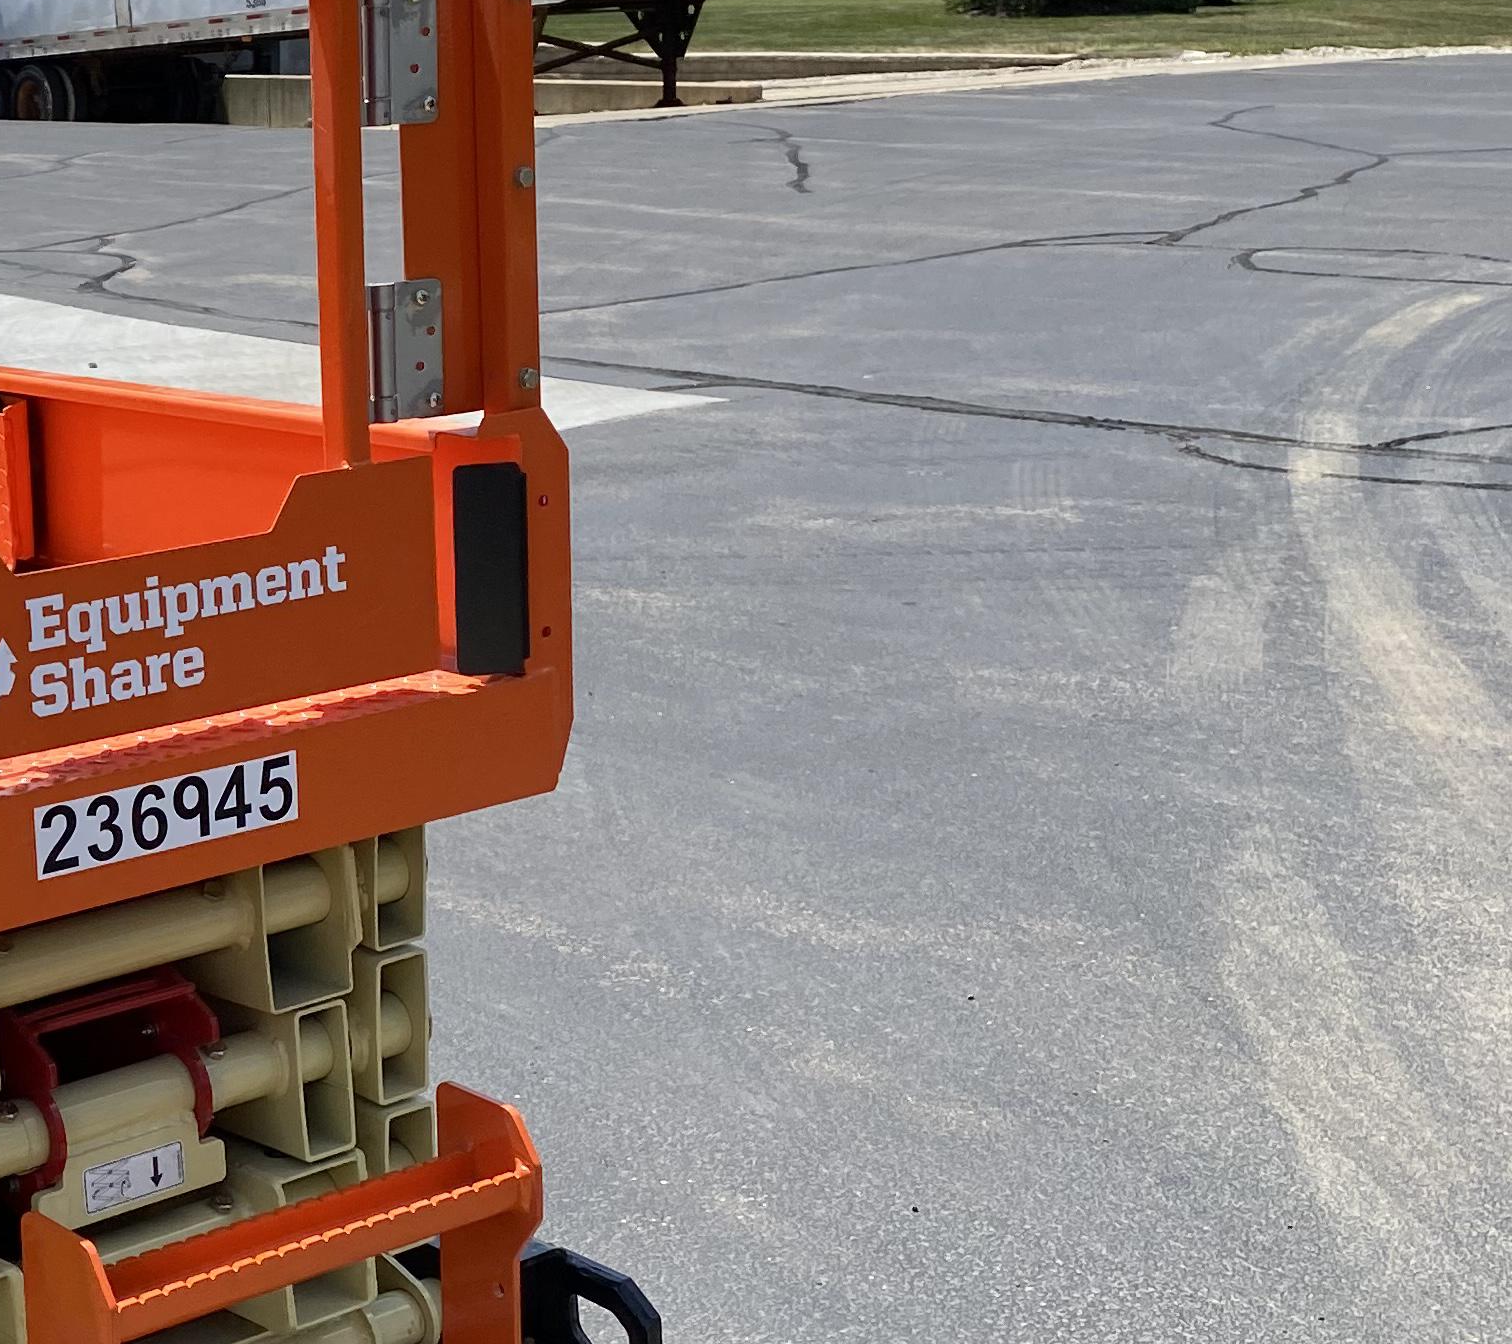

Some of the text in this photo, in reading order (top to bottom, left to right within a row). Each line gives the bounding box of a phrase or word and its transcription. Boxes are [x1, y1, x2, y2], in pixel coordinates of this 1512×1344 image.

[25, 545, 347, 654] Equipment
[29, 646, 205, 718] Share
[39, 754, 294, 876] 236945
